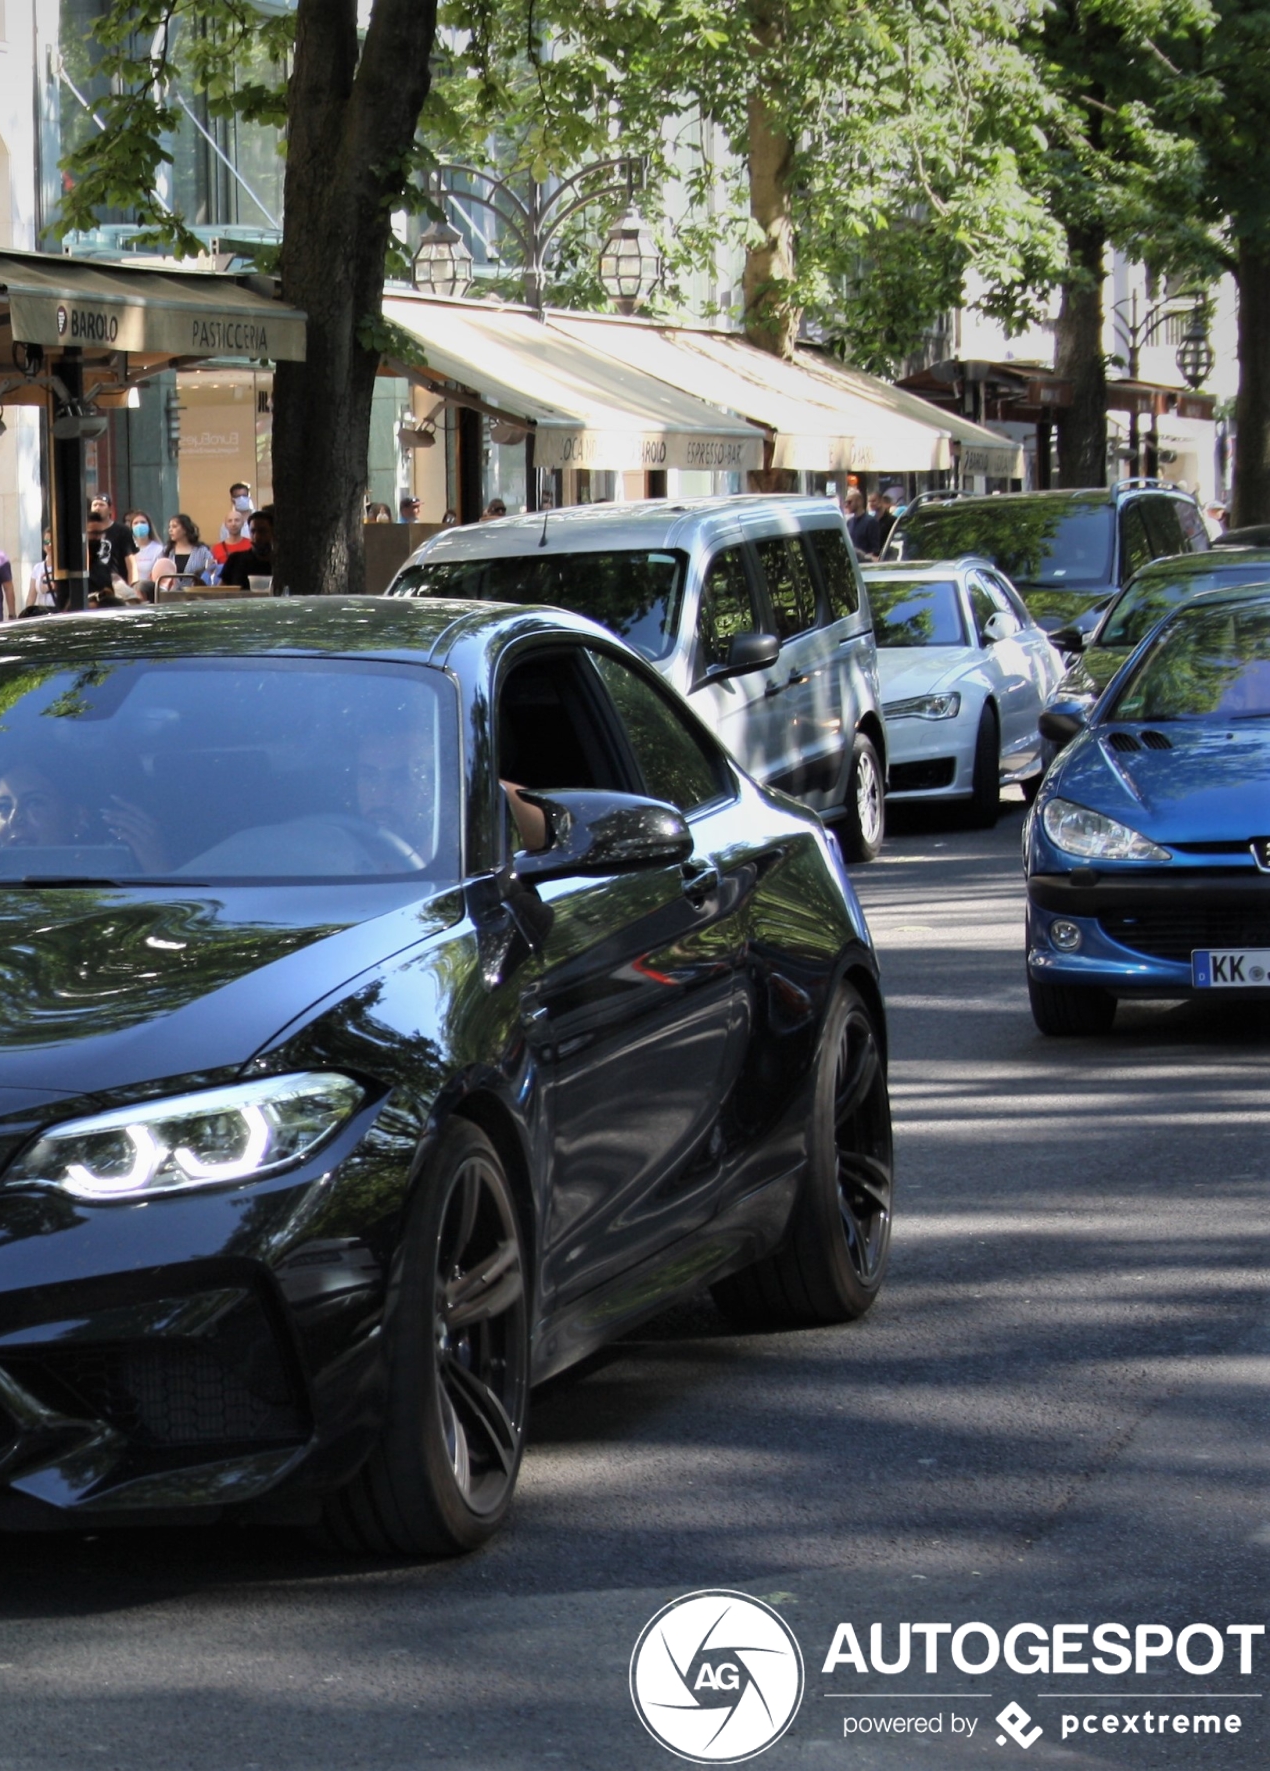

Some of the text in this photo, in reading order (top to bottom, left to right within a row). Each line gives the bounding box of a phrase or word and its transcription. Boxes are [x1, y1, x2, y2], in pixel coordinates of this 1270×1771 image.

[71, 309, 119, 343] BAROLO
[191, 319, 268, 351] PASTICCERIA
[637, 440, 667, 463] AROLO
[686, 441, 743, 465] ESPRESSO-BAR
[1211, 955, 1246, 982] KK
